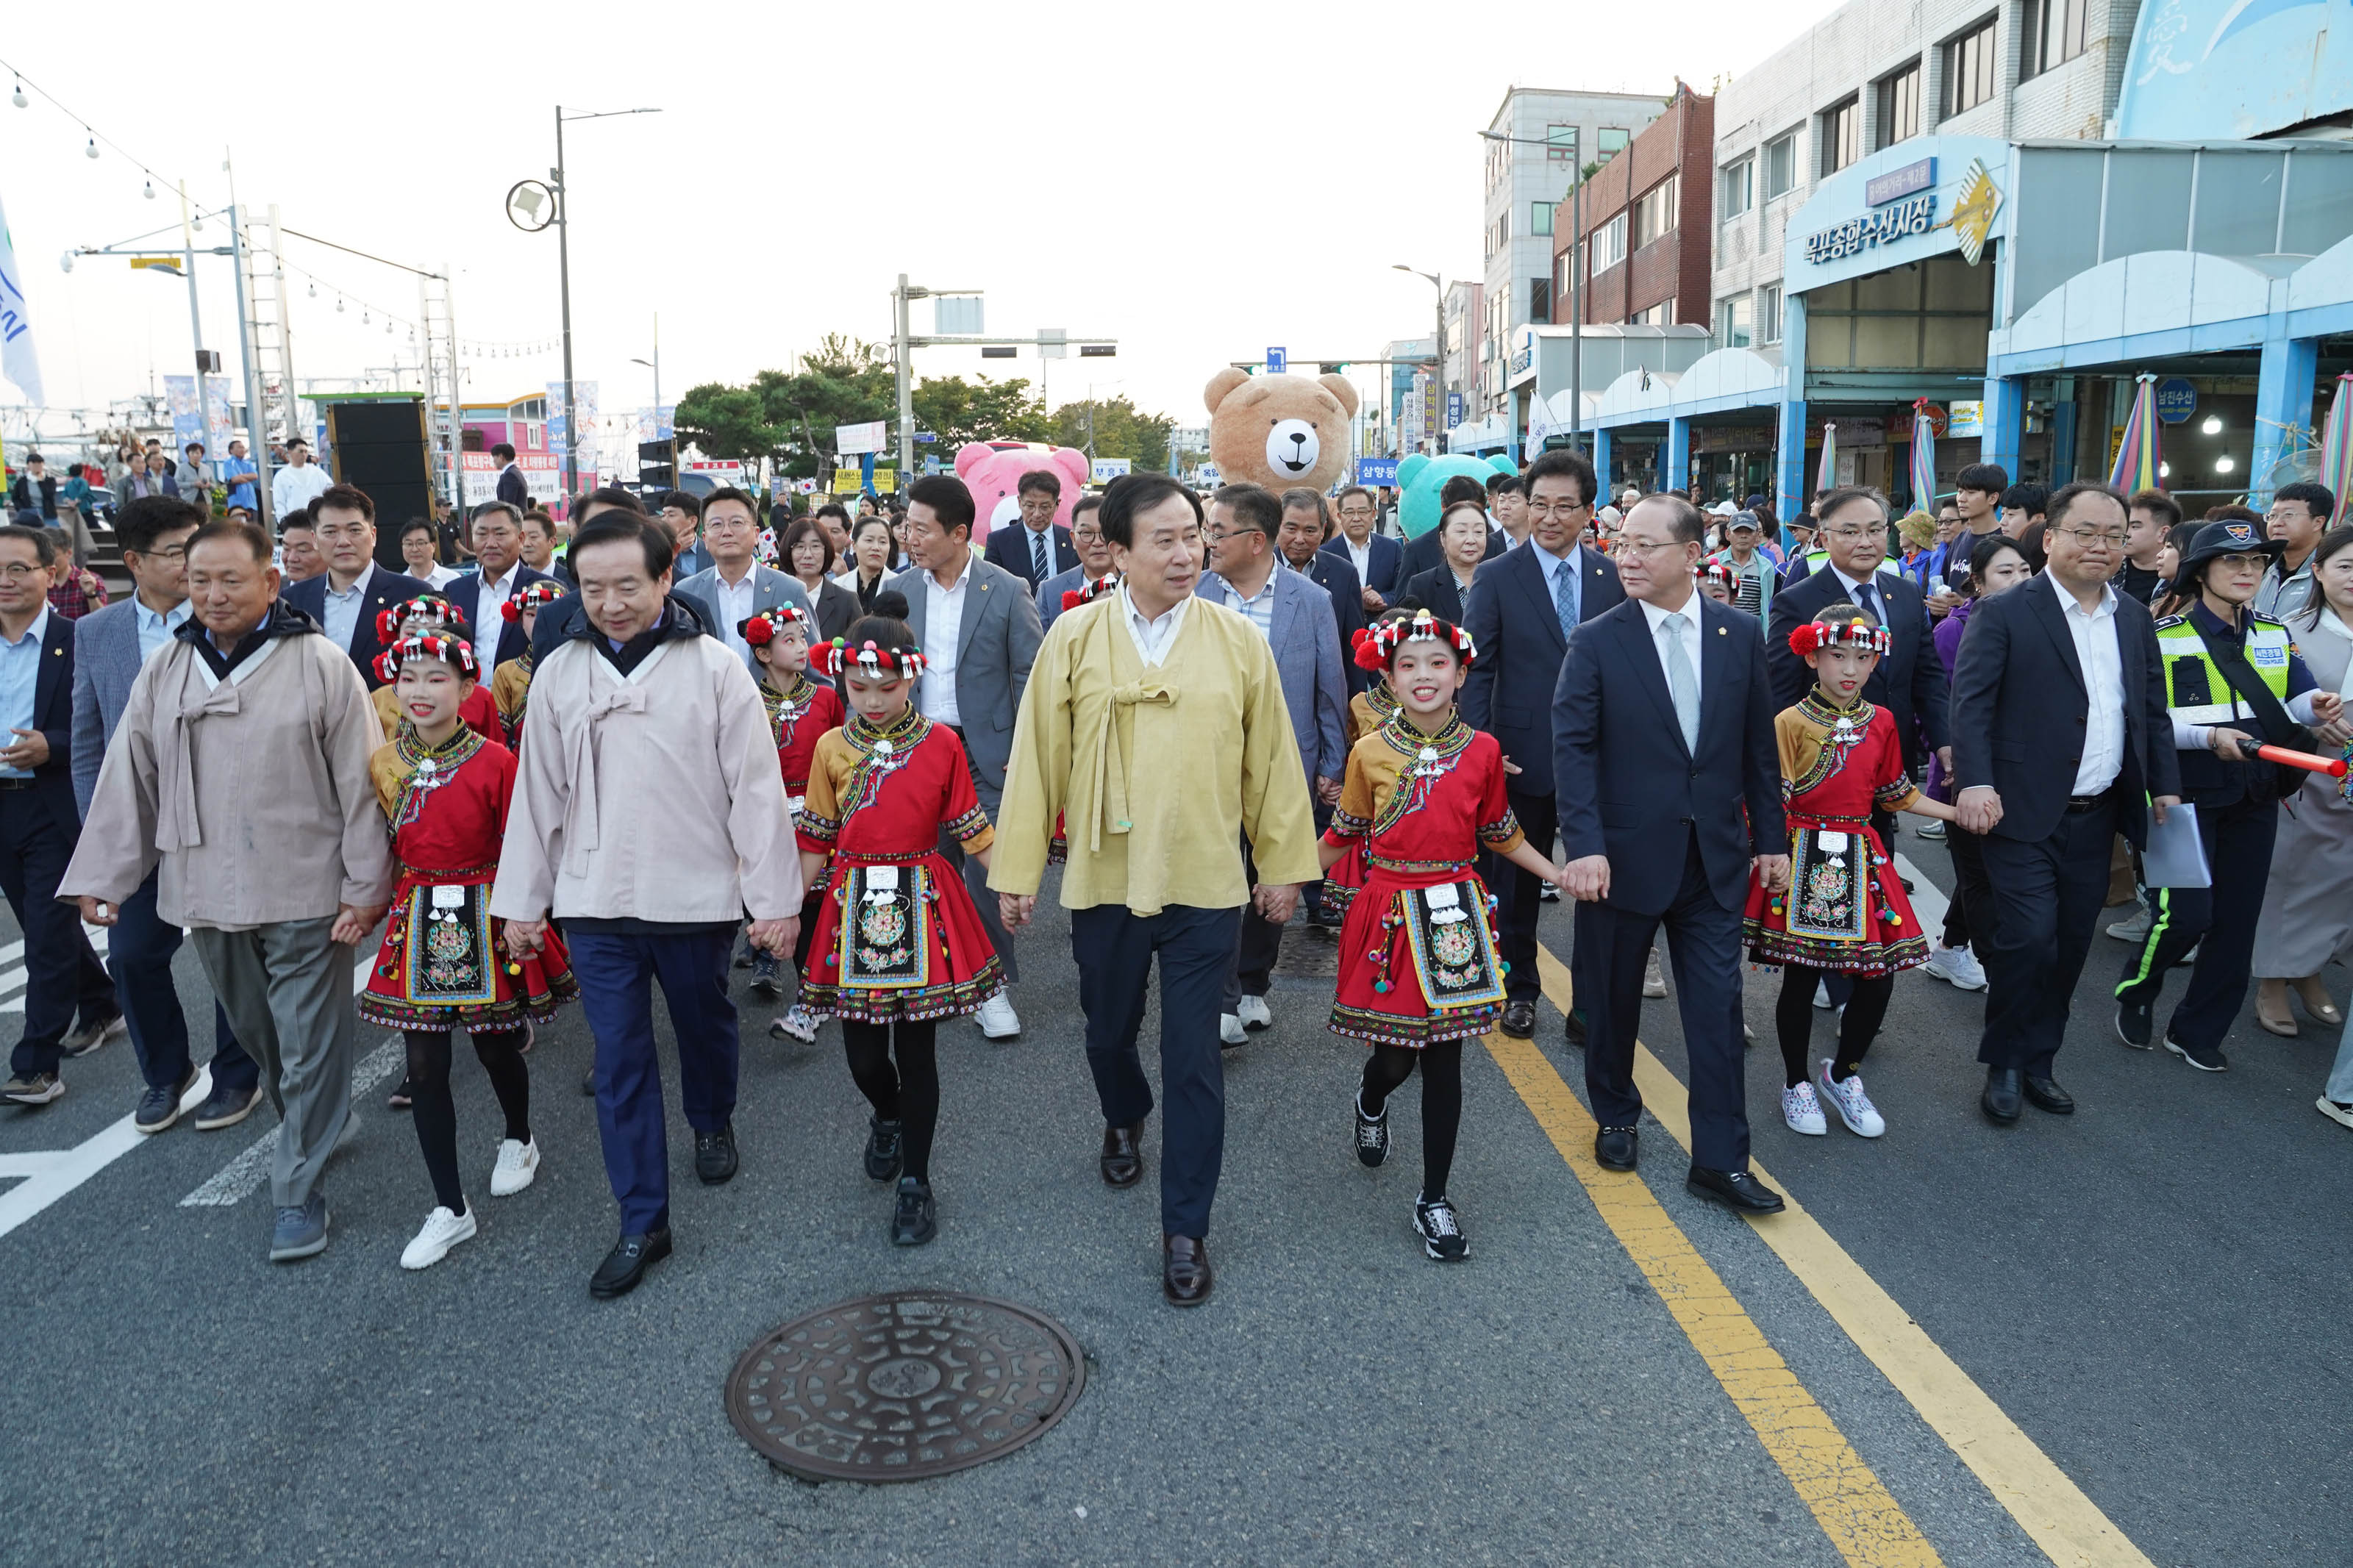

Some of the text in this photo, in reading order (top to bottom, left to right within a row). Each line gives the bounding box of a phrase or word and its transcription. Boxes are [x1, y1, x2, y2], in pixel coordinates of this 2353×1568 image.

[1804, 196, 1932, 265] 목포종합수산시장
[1426, 384, 1435, 430] 삼학마트
[2158, 390, 2194, 405] 남진수산
[1363, 465, 1396, 479] 삼향동
